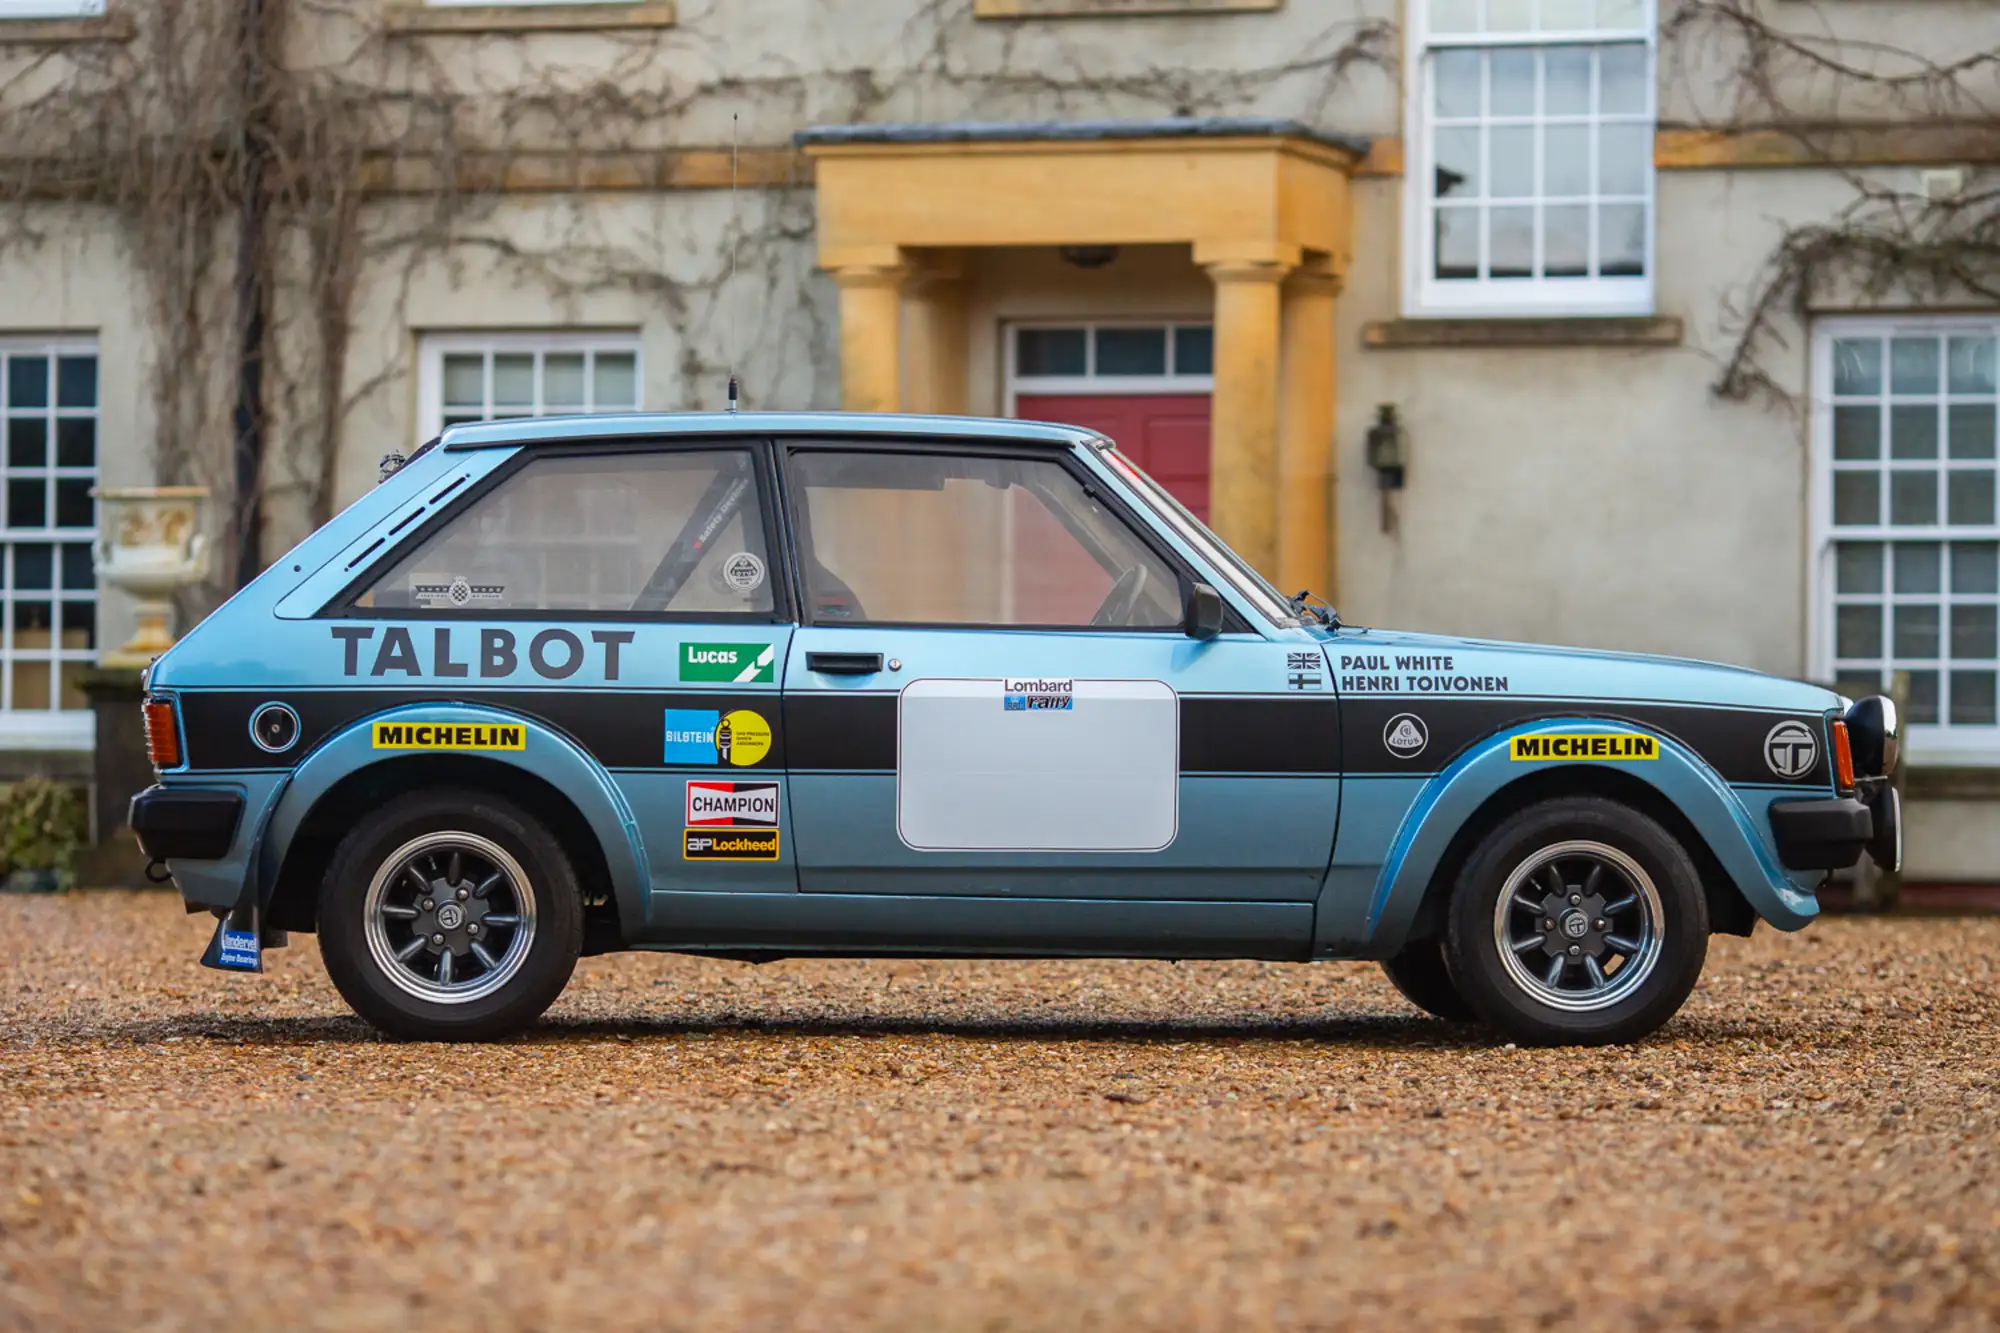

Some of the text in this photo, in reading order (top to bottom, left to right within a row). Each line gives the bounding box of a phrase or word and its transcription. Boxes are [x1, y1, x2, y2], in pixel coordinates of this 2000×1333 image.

[330, 626, 636, 681] TALBOT
[688, 646, 738, 664] Lucas
[1341, 655, 1454, 671] PAUL WHITE
[1004, 678, 1073, 693] Lombard
[1341, 676, 1509, 692] HENRI TOIVONEN
[379, 726, 520, 746] MICHELIN
[666, 730, 714, 743] BILSTEIN
[1392, 737, 1420, 746] LOTUS
[1516, 737, 1653, 757] MICHELIN
[692, 796, 775, 813] CHAMPION
